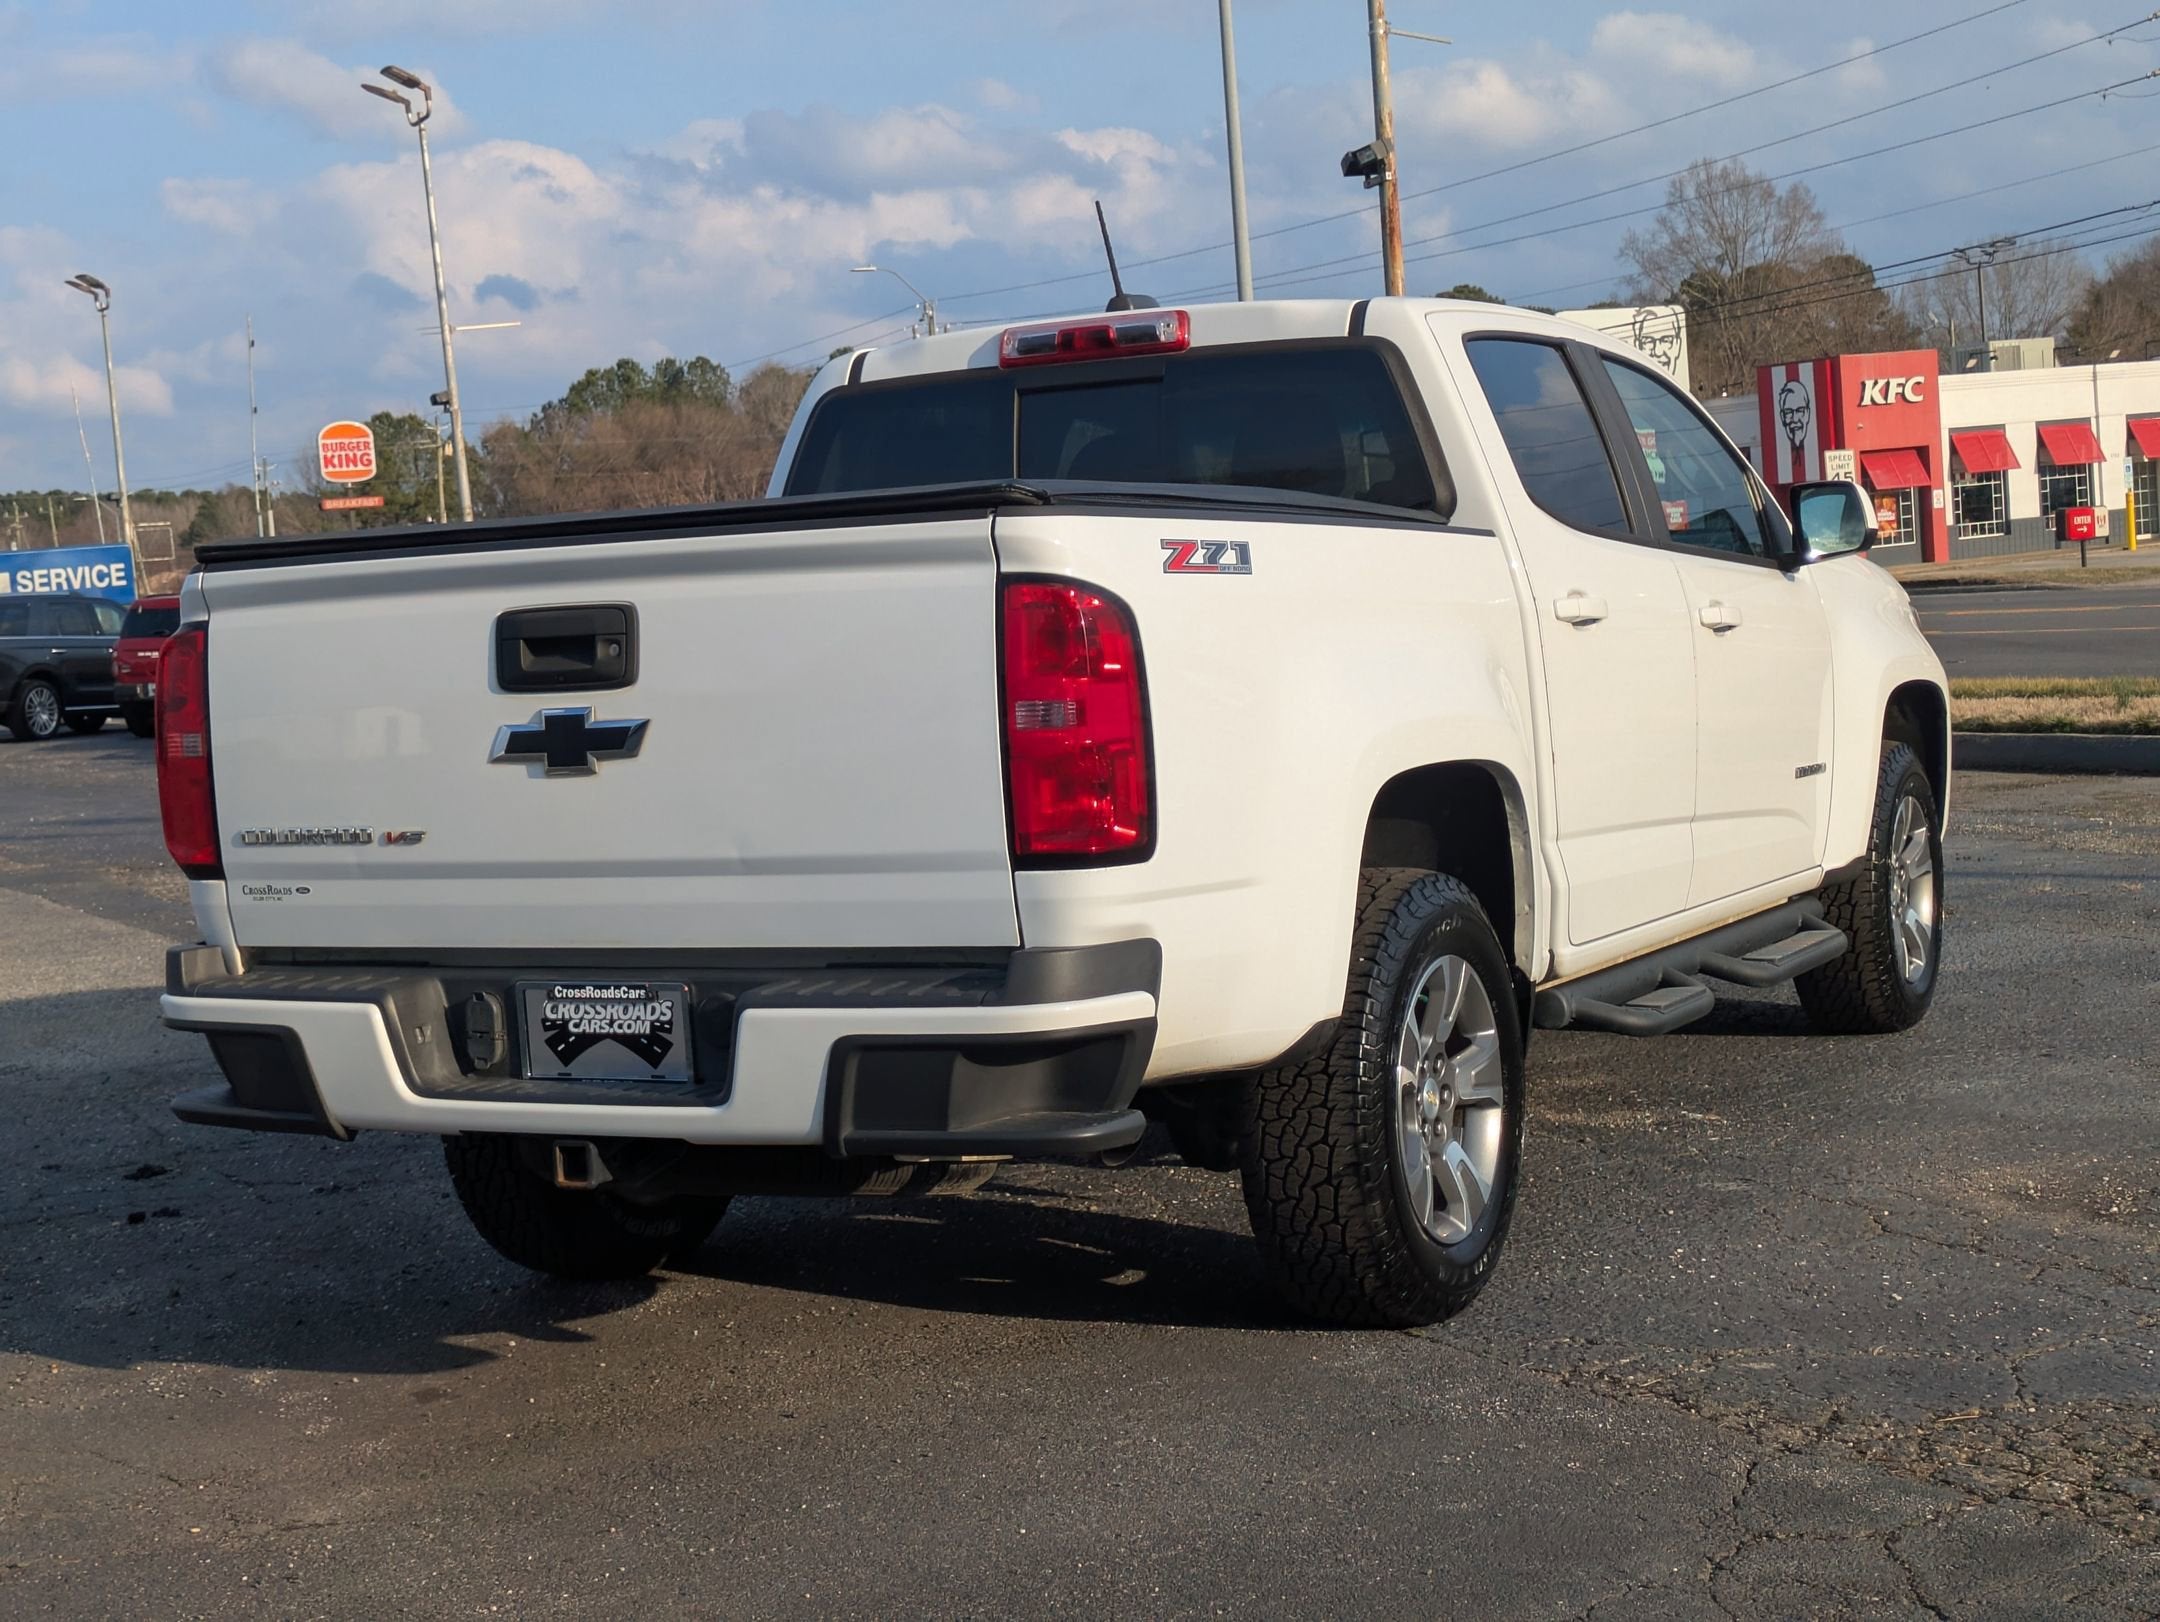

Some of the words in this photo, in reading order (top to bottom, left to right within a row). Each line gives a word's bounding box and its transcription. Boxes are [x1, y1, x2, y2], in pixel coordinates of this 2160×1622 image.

[1859, 376, 1925, 406] KFC
[322, 441, 371, 453] BURGER
[323, 453, 373, 469] KING
[1828, 454, 1852, 462] SPEED
[1831, 463, 1850, 471] LIMIT
[2073, 515, 2091, 525] ENTER
[1160, 539, 1253, 574] Z71
[16, 563, 128, 593] SERVICE
[241, 826, 375, 845] COLORADO
[554, 985, 646, 999] CrossRoadsCars
[545, 1000, 673, 1021] CROSSROADS
[568, 1019, 651, 1034] CARS.COM
